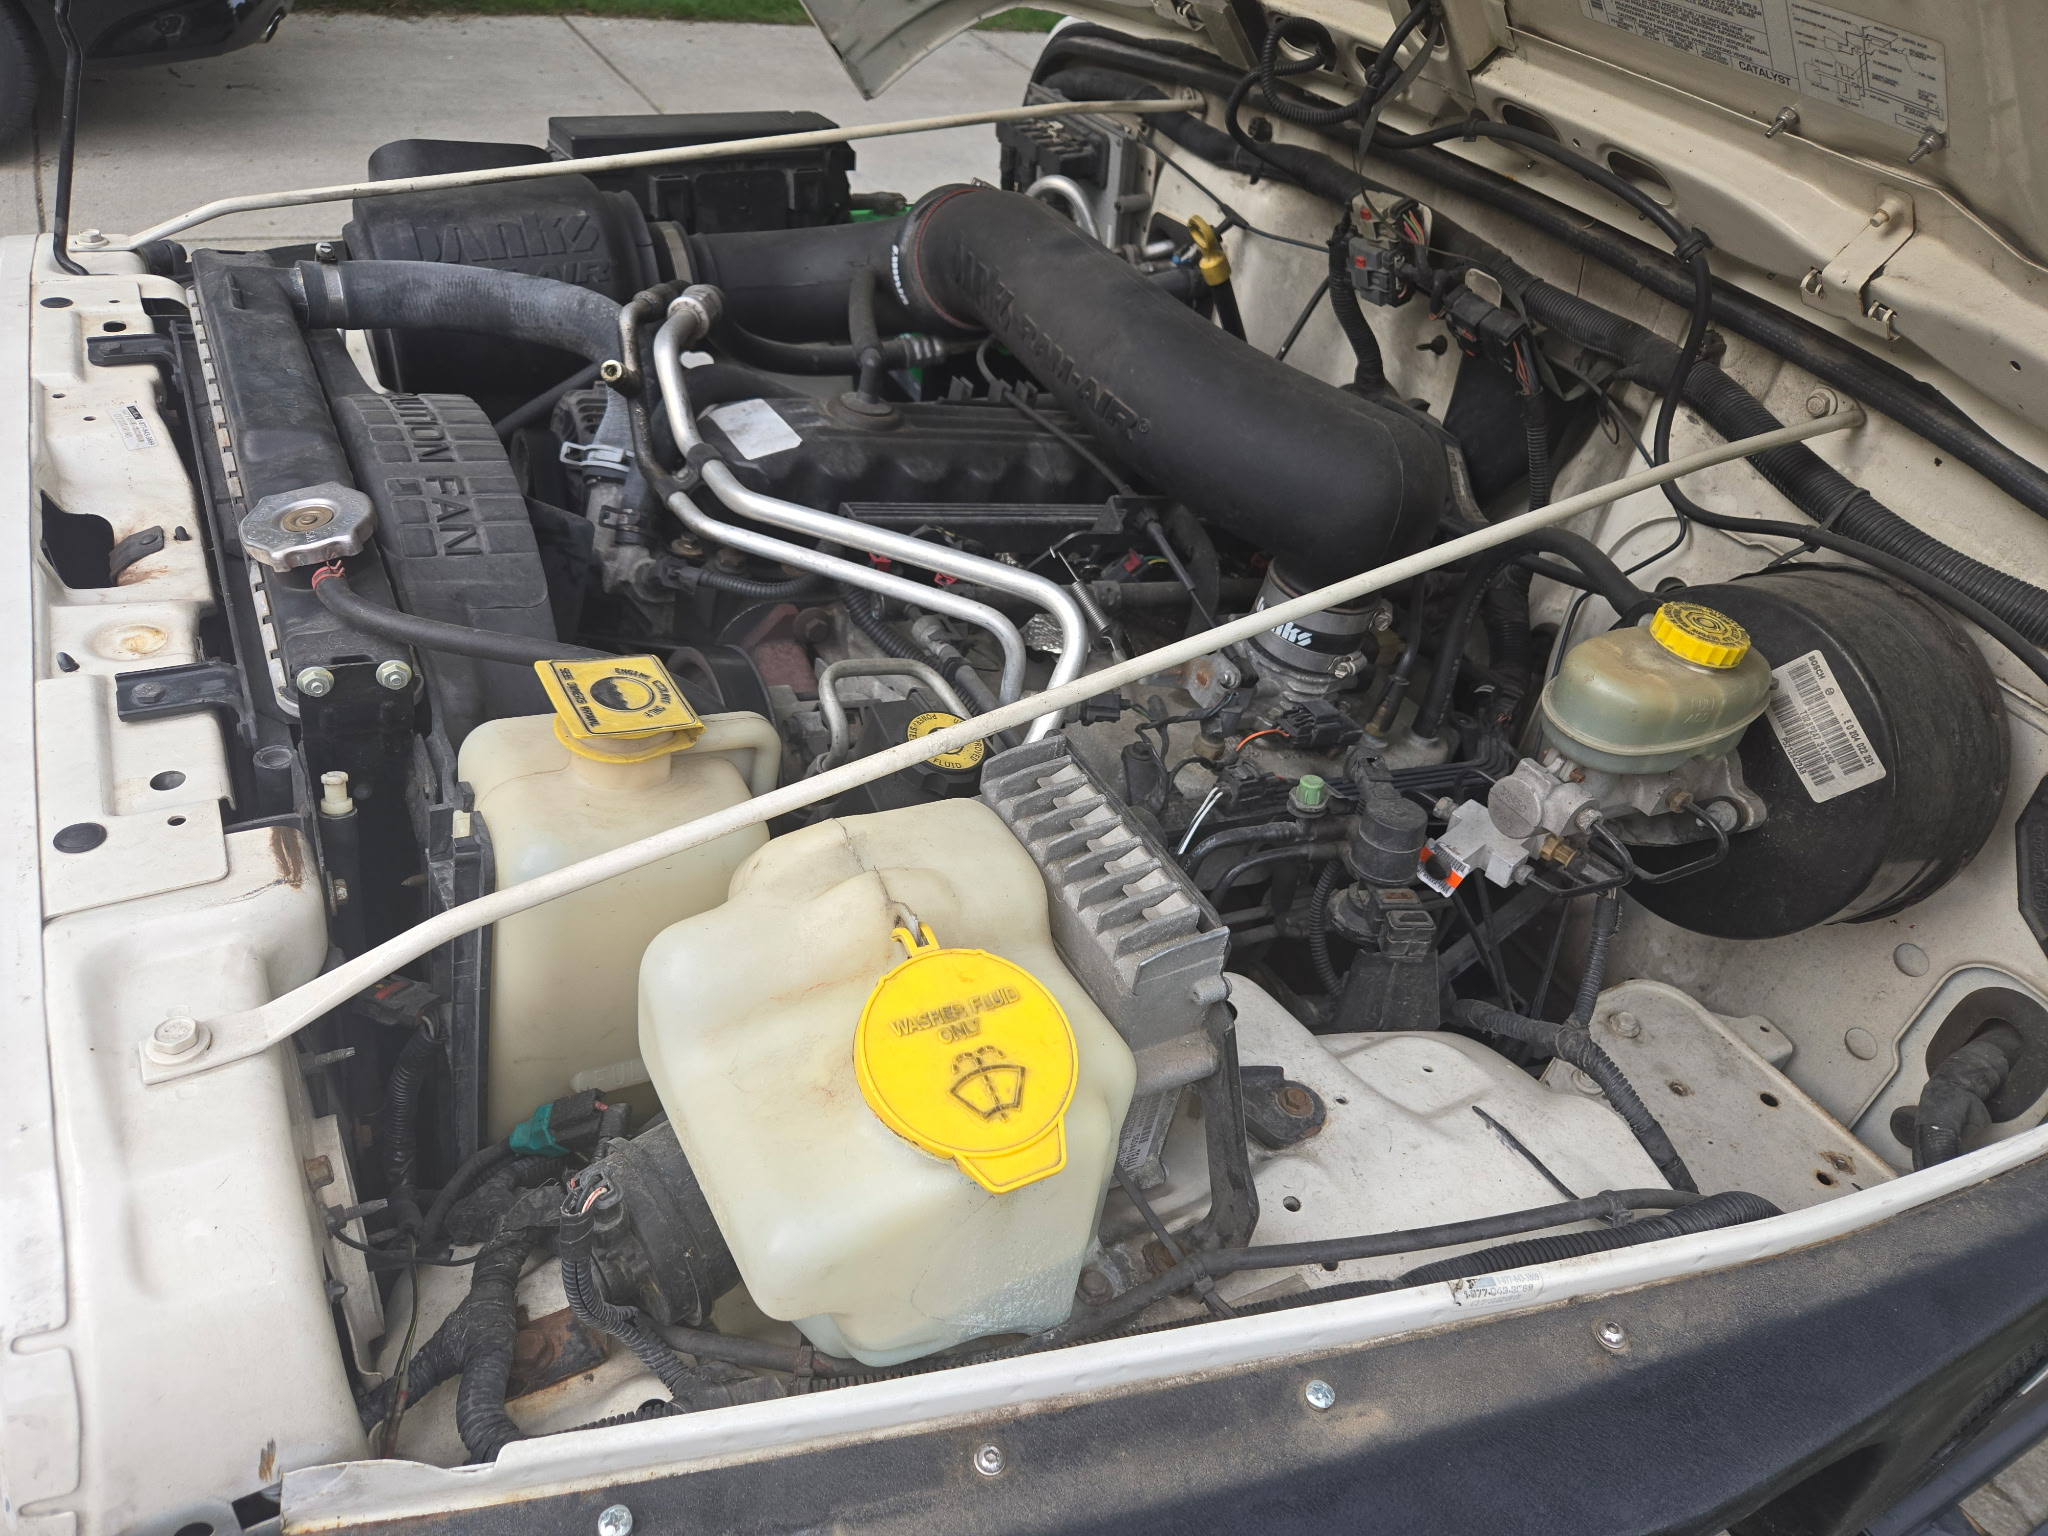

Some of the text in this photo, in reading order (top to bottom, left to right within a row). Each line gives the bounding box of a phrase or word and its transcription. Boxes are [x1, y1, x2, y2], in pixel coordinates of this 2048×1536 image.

[1738, 60, 1792, 87] CATALYST
[424, 475, 483, 557] FAN
[1807, 654, 1826, 680] BOSCH
[917, 713, 937, 726] POWER
[933, 757, 962, 769] FLUID
[889, 986, 1022, 1037] WASHER FLUID
[937, 1017, 981, 1044] ONLY
